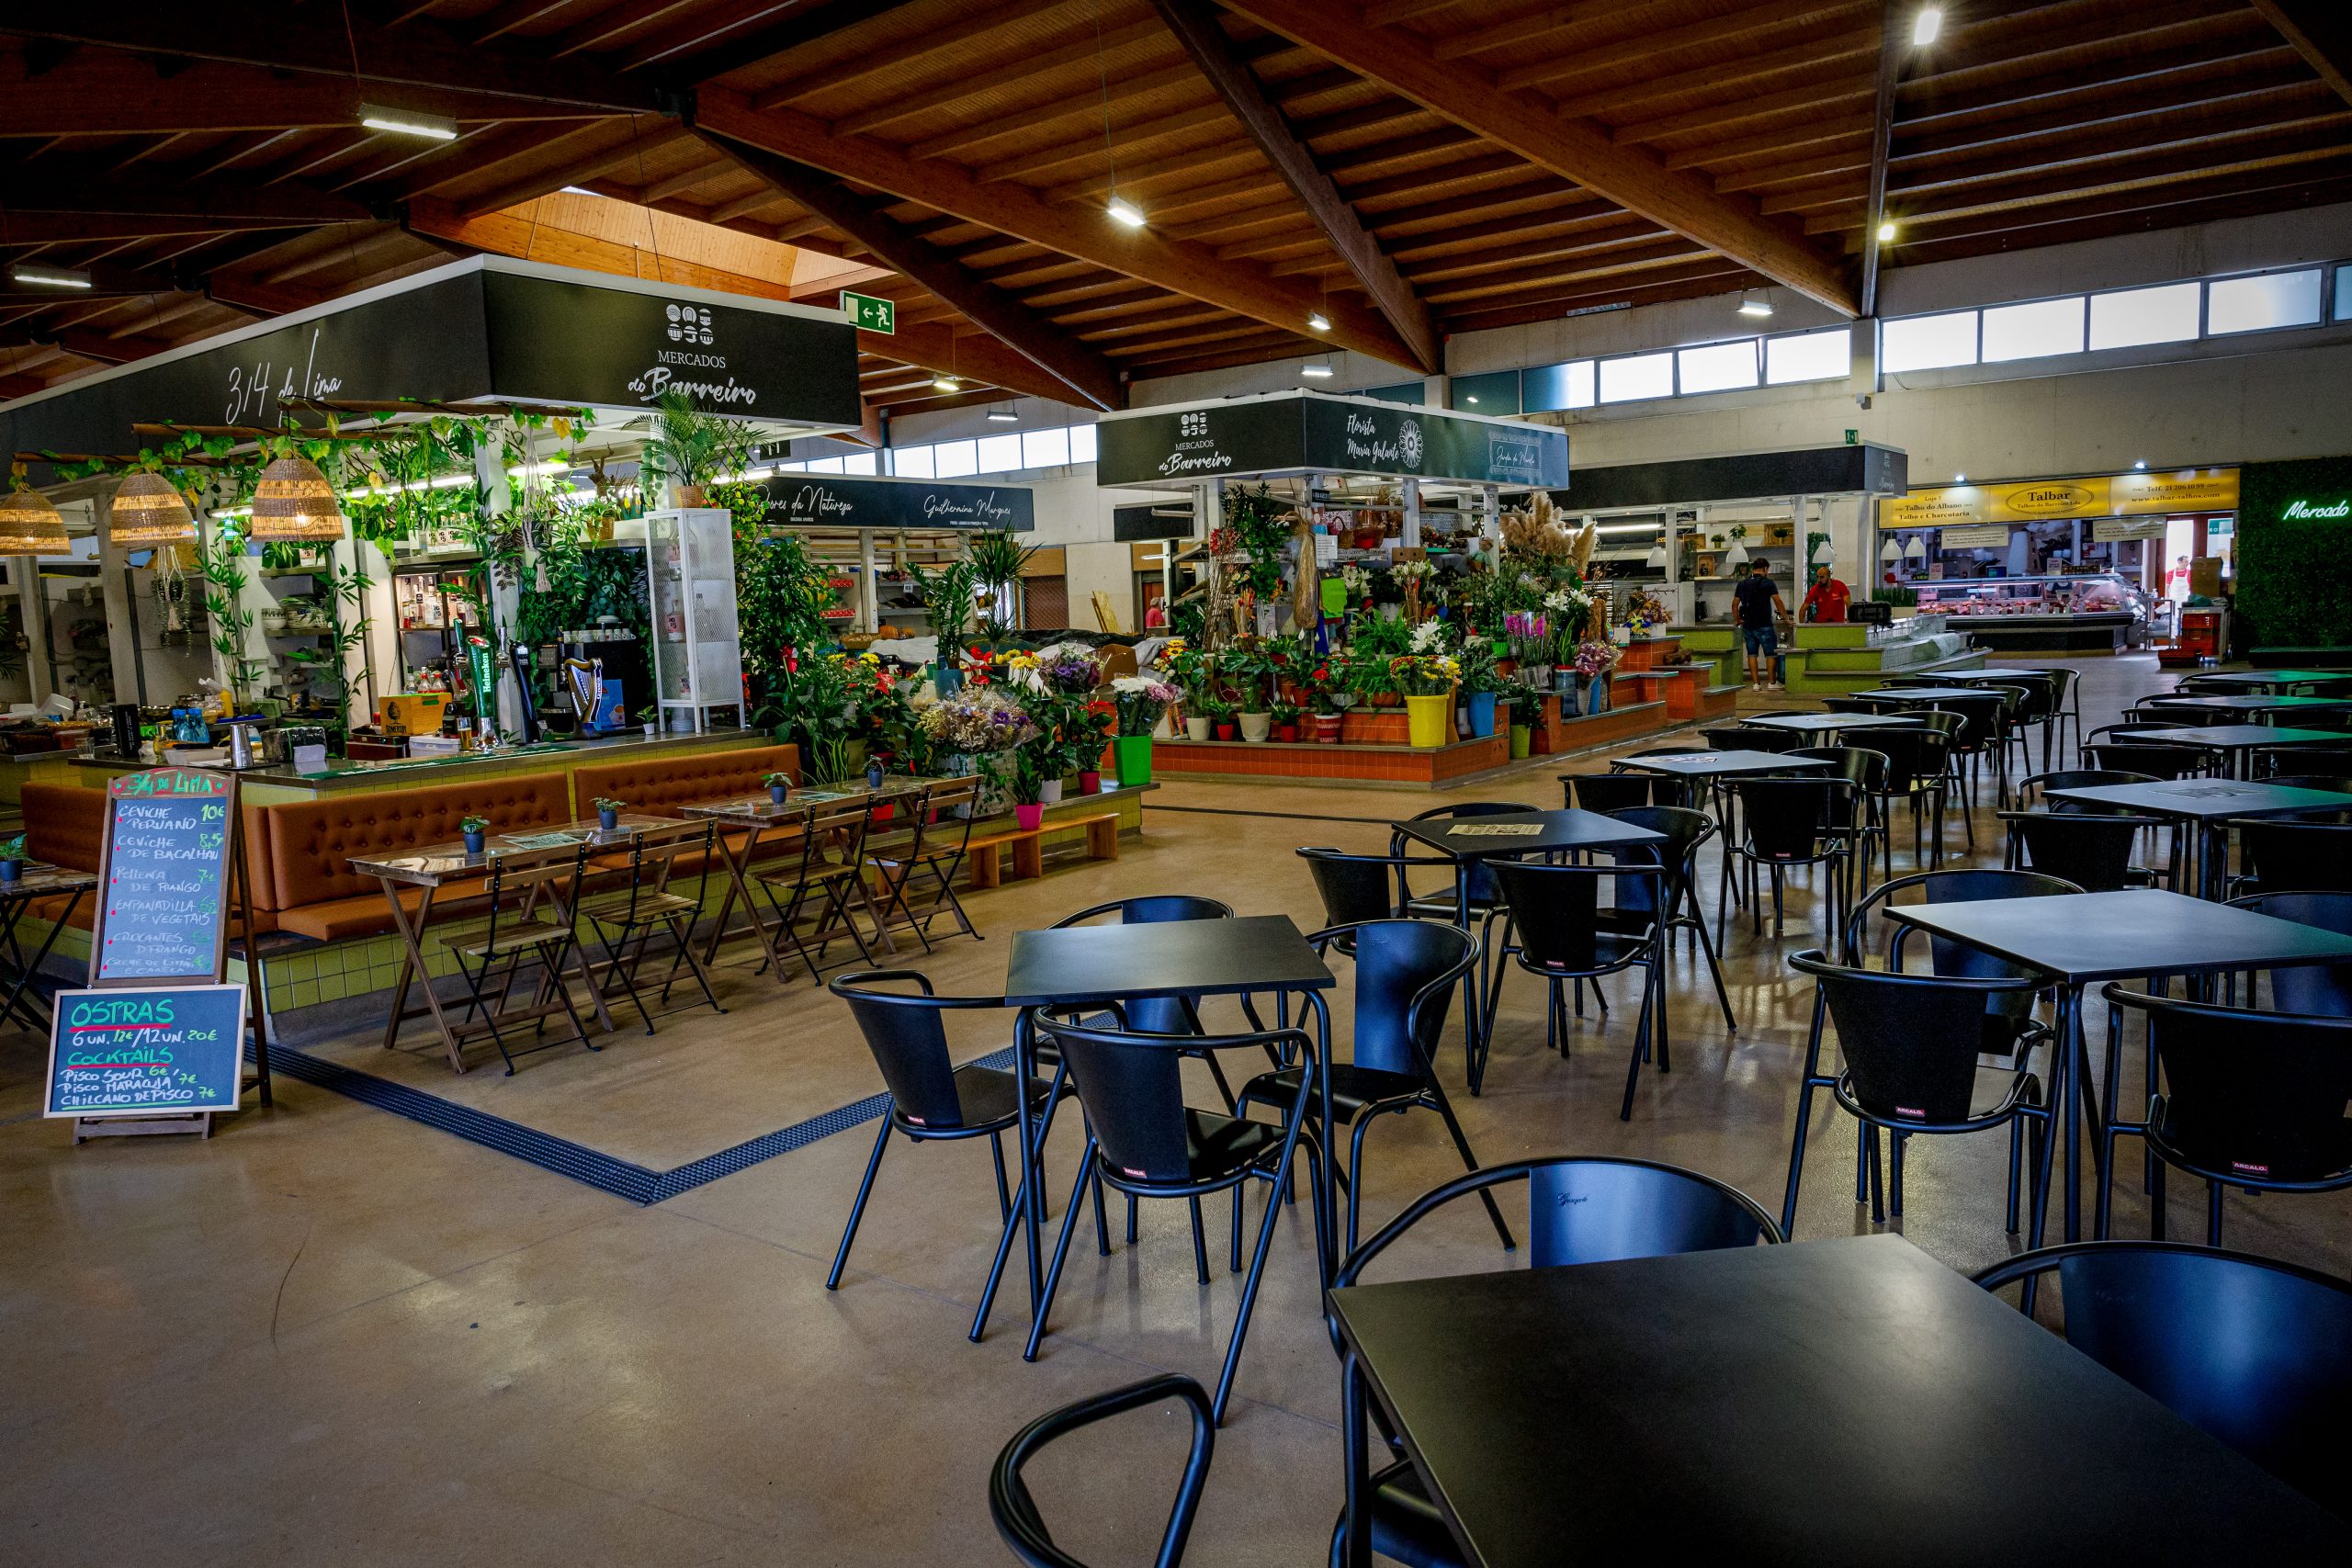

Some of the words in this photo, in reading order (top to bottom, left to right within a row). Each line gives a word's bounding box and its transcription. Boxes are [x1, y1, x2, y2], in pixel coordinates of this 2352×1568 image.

[657, 350, 726, 368] MERCADOS
[628, 378, 646, 393] do
[640, 367, 757, 405] Barreiro
[1347, 413, 1376, 435] Florista
[1175, 439, 1214, 451] MERCADOS
[1347, 438, 1372, 459] Maria
[1372, 440, 1399, 464] Galante
[1159, 462, 1169, 471] do
[1165, 450, 1232, 476] Barreiro
[791, 491, 804, 514] da
[2028, 491, 2070, 502] Talbar
[2132, 493, 2220, 502] www.talbar-talhos.com
[923, 494, 974, 519] Guilhermina
[976, 491, 1011, 520] Marques
[2282, 500, 2350, 521] Mercado
[481, 652, 492, 694] Heineken
[127, 773, 154, 795] 3/4
[118, 805, 172, 819] CEVICHE
[200, 804, 225, 821] 10€
[126, 818, 197, 829] PERUANO
[118, 835, 176, 849] CEVICHE
[128, 849, 150, 858] DE
[154, 848, 220, 860] BACALHAU
[198, 869, 217, 883] 7€
[130, 883, 151, 892] DE
[158, 881, 201, 893] FRANGO
[132, 913, 147, 923] DE
[152, 912, 210, 926] VEGETAIS
[113, 931, 183, 943] CROCANTES
[71, 998, 175, 1027] OSTRAS
[73, 1031, 85, 1046] 6
[87, 1032, 110, 1044] UN.
[162, 1031, 186, 1044] UN.
[187, 1029, 218, 1042] 20€
[103, 1068, 145, 1084] SOUR
[149, 1066, 168, 1077] 6€
[178, 1073, 198, 1085] 7€
[198, 1086, 218, 1100] 7€
[2234, 1162, 2265, 1171] ARCALO
